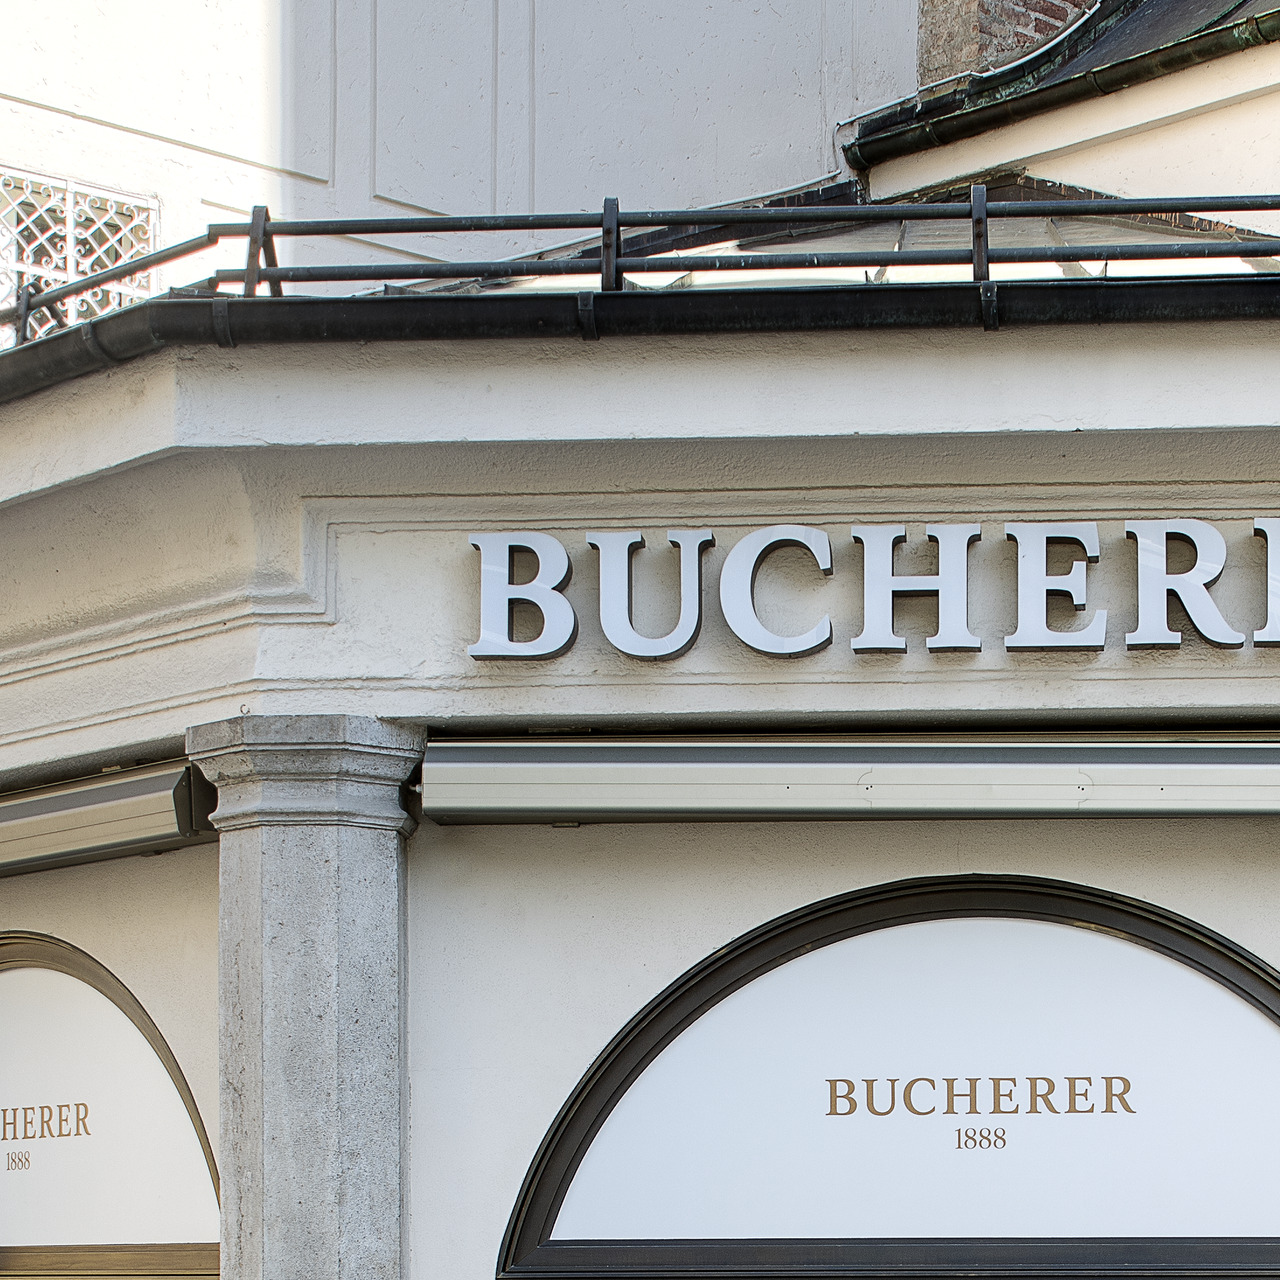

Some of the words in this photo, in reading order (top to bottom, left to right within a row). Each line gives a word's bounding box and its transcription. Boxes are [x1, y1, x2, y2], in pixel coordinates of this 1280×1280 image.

[824, 1076, 1137, 1116] BUCHERER
[954, 1127, 1007, 1150] 1888
[6, 1150, 31, 1171] 1888
